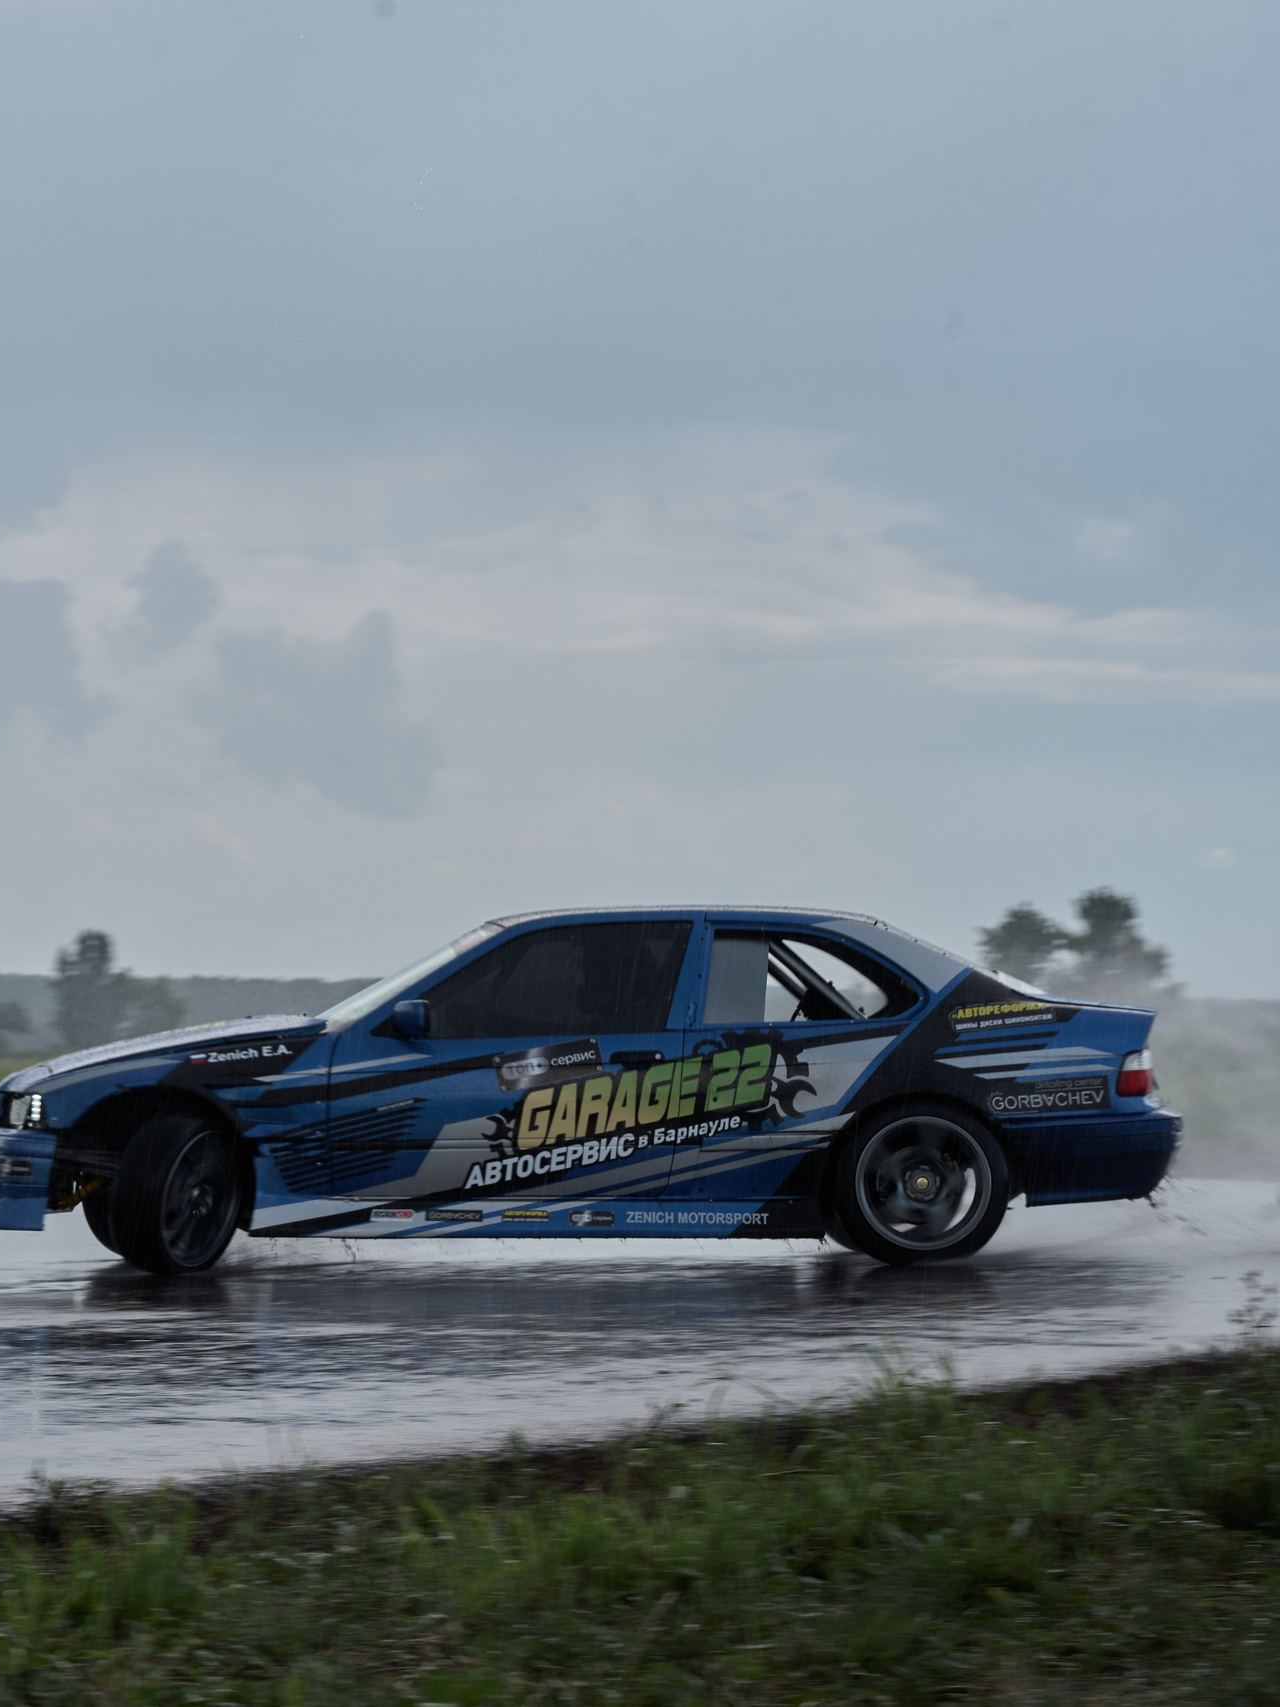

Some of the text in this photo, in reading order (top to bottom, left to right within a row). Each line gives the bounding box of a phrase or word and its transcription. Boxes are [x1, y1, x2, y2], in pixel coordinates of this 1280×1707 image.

[207, 1044, 294, 1063] Zenich E.A.
[506, 1050, 596, 1076] ТОП сервис
[517, 1043, 772, 1150] GARAGE 22
[464, 1115, 741, 1190] АВТОСЕРВИС в Барнауле
[626, 1211, 769, 1225] ZENICH MOTORSPORT
